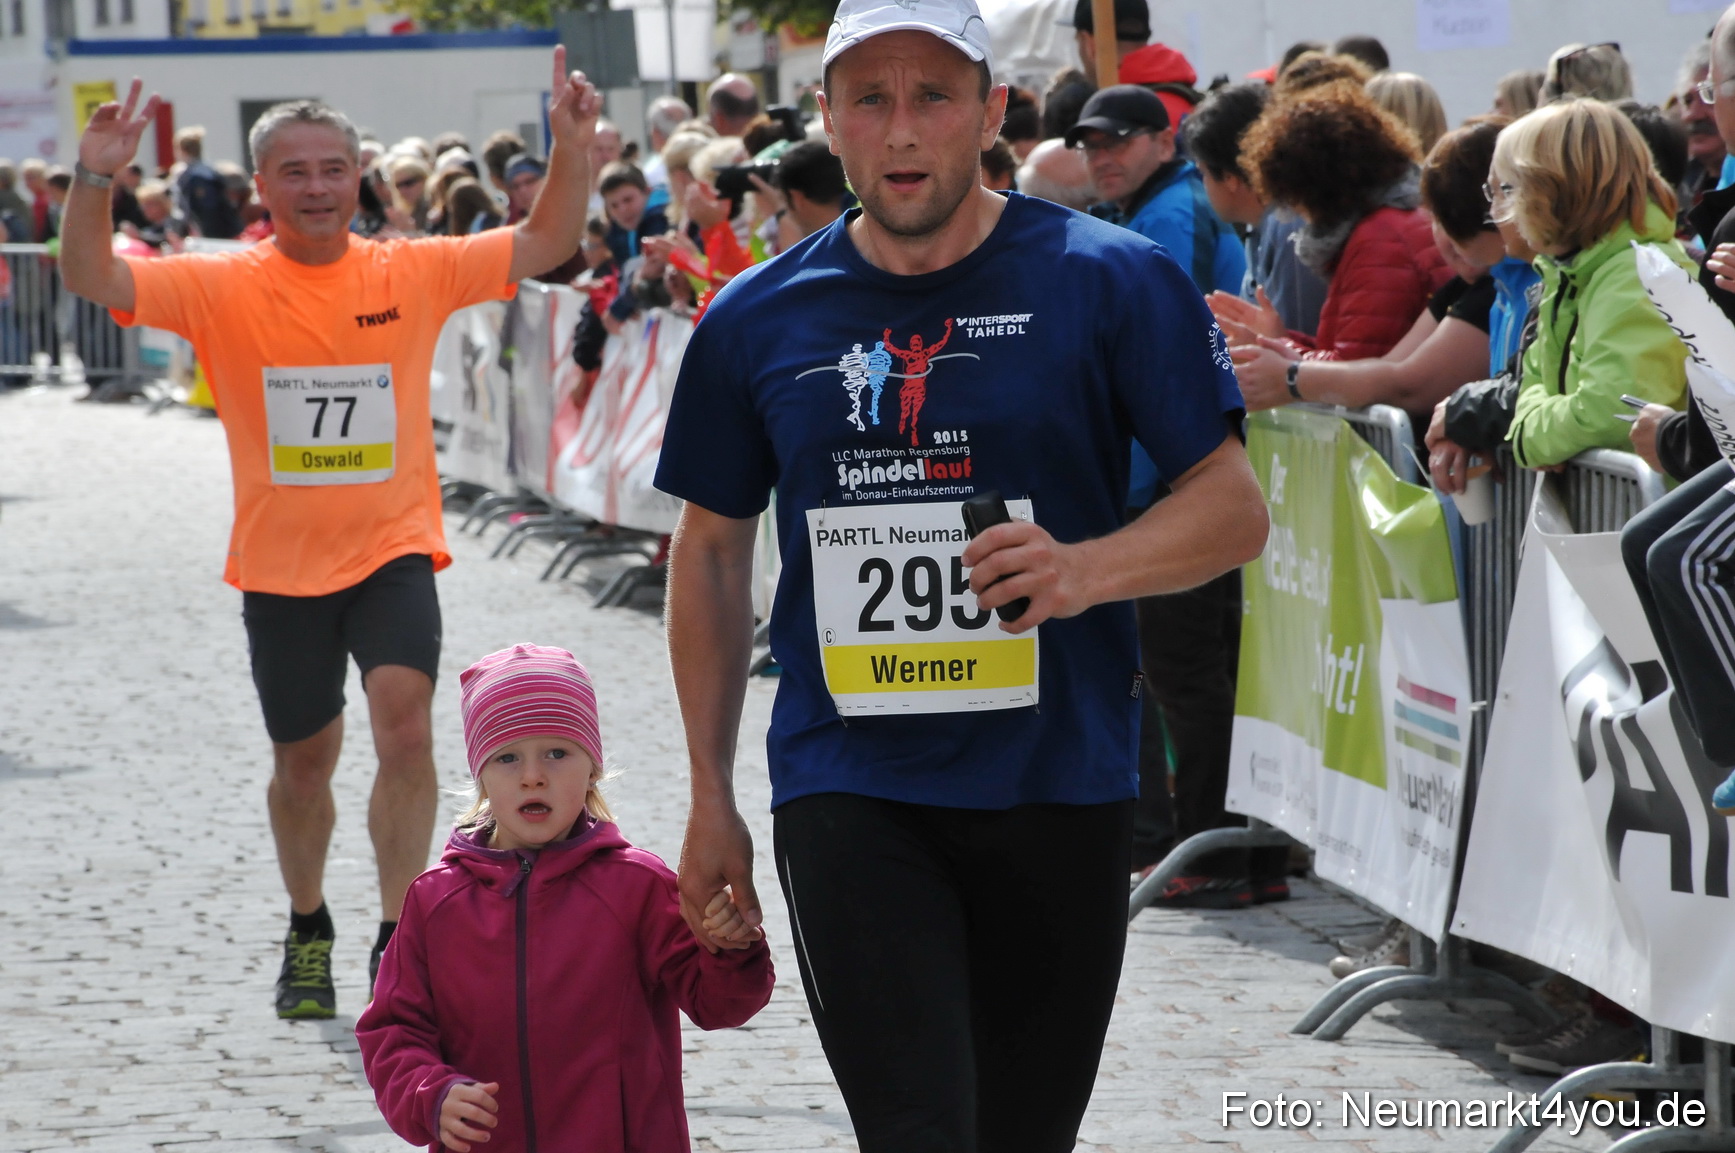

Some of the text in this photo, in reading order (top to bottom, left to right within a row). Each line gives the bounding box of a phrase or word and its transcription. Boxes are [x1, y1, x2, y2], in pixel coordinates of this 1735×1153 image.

[968, 313, 1033, 326] INTERSPORT
[966, 325, 1026, 338] TAHEDL
[267, 379, 372, 390] PARTL Neumarkt
[305, 396, 358, 438] 77
[933, 430, 968, 444] 2015
[302, 451, 363, 469] Oswald
[832, 445, 970, 463] LLC Marathon Regensburg
[837, 457, 972, 491] Spindellauf
[842, 484, 975, 501] im Donau-Einkaufszentrum
[816, 527, 883, 547] PARTL
[871, 655, 977, 683] Werner
